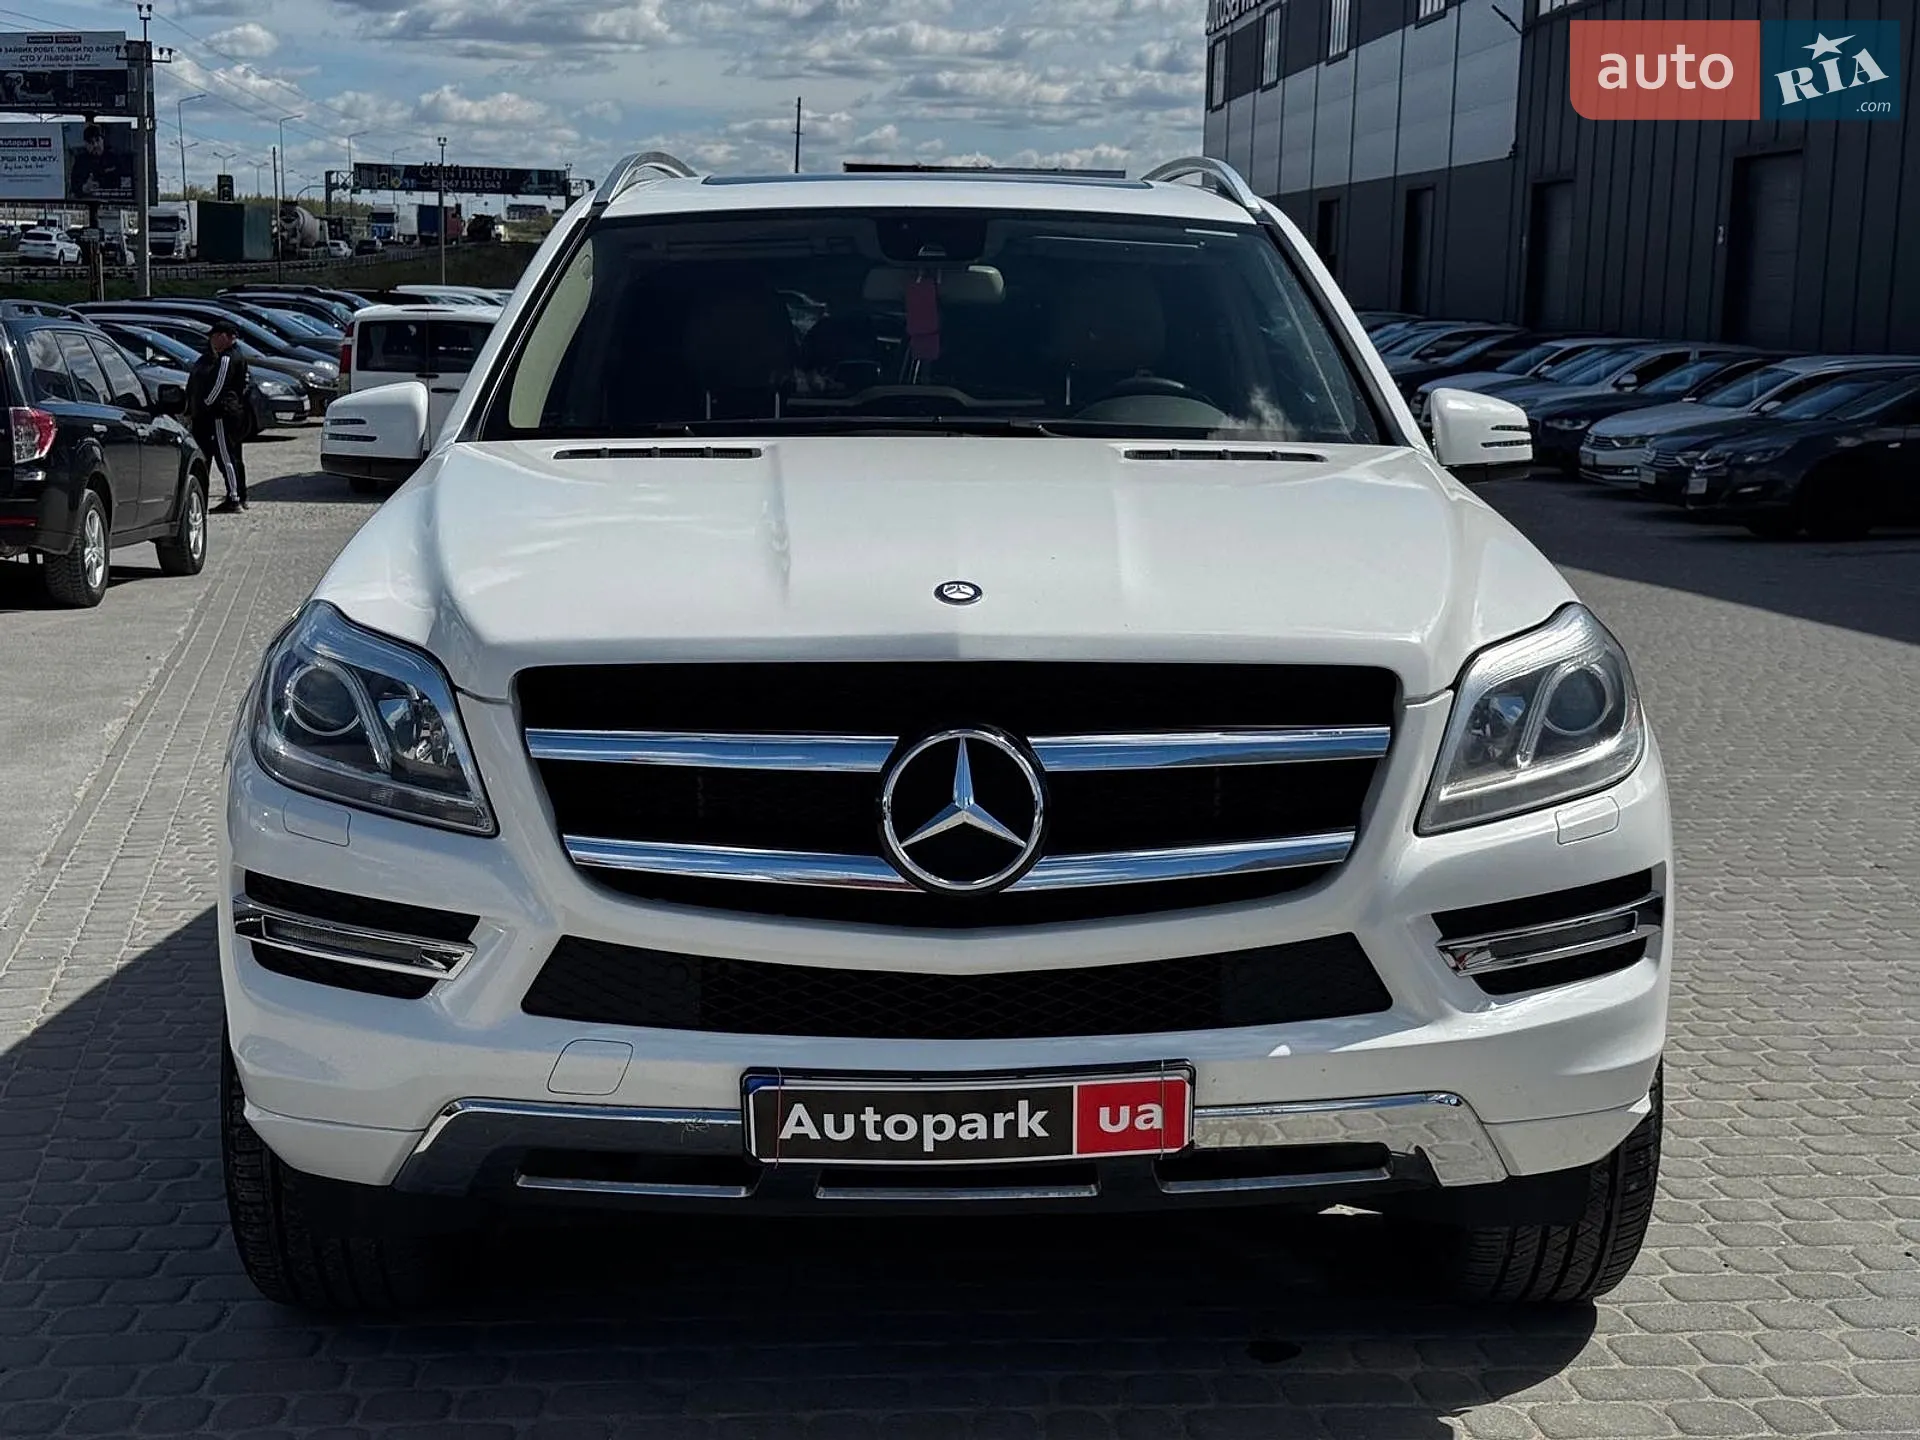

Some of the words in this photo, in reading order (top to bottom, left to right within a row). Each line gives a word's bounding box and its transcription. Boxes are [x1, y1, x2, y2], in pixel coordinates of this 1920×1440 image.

[420, 166, 512, 181] CONTINENT
[778, 1099, 1050, 1152] Autopark
[1098, 1102, 1163, 1133] ua
